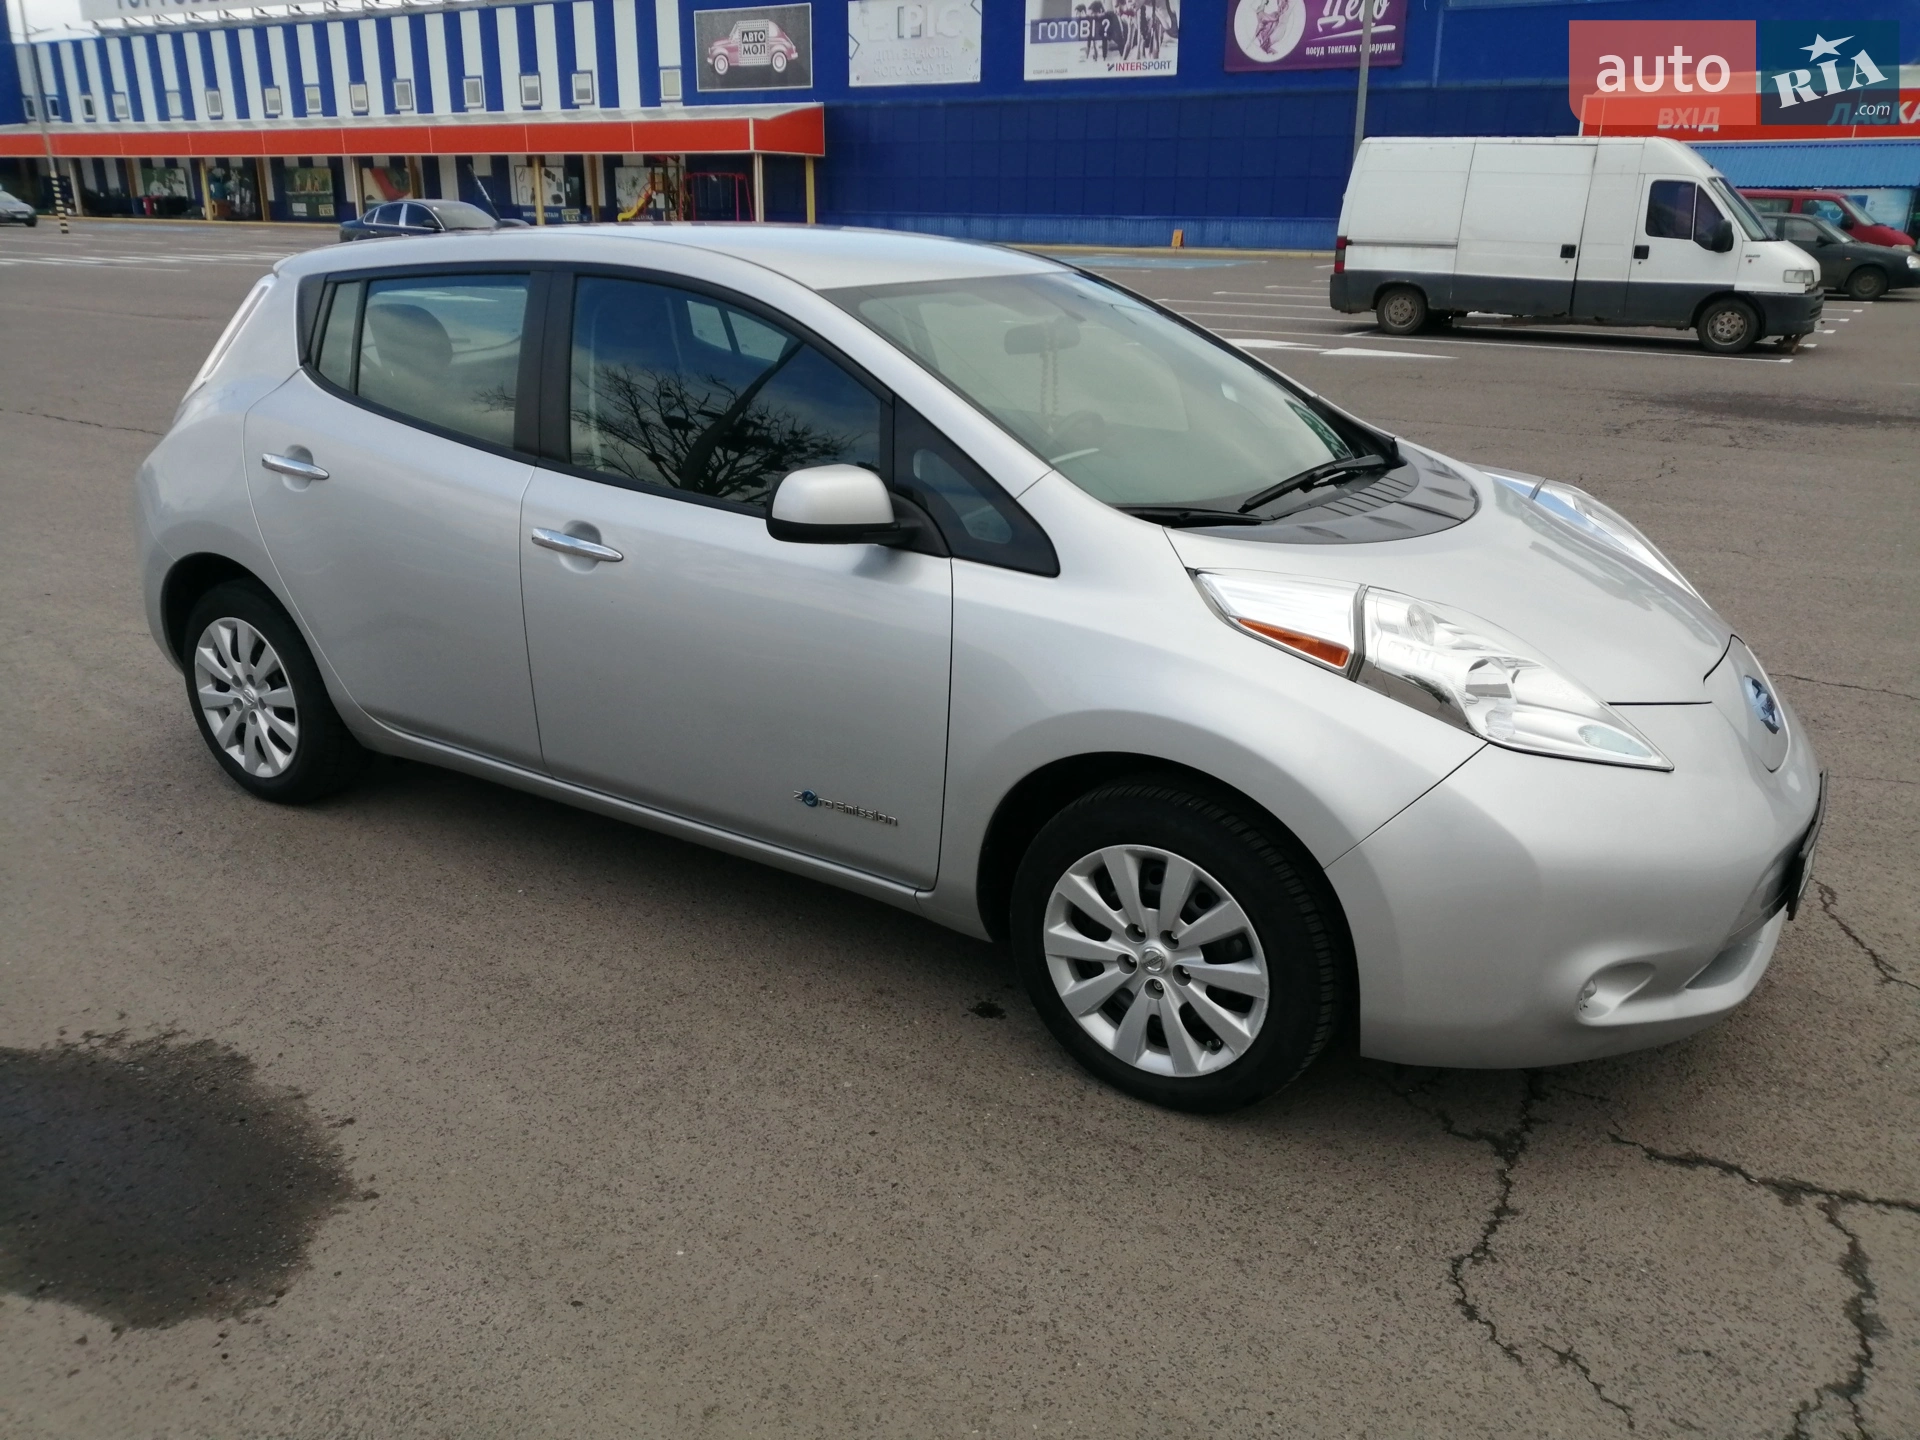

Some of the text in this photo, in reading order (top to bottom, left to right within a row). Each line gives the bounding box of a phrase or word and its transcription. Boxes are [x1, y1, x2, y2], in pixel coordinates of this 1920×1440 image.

[1317, 0, 1391, 33] Део
[743, 31, 765, 43] АВТО
[1038, 19, 1096, 40] ГОТОВІ
[743, 44, 766, 55] МОЛ
[1305, 46, 1325, 57] посуд
[1327, 44, 1357, 54] текстиль
[1115, 60, 1172, 72] INTERSPORT
[1657, 106, 1720, 132] ВХІД
[836, 801, 898, 826] Emission
